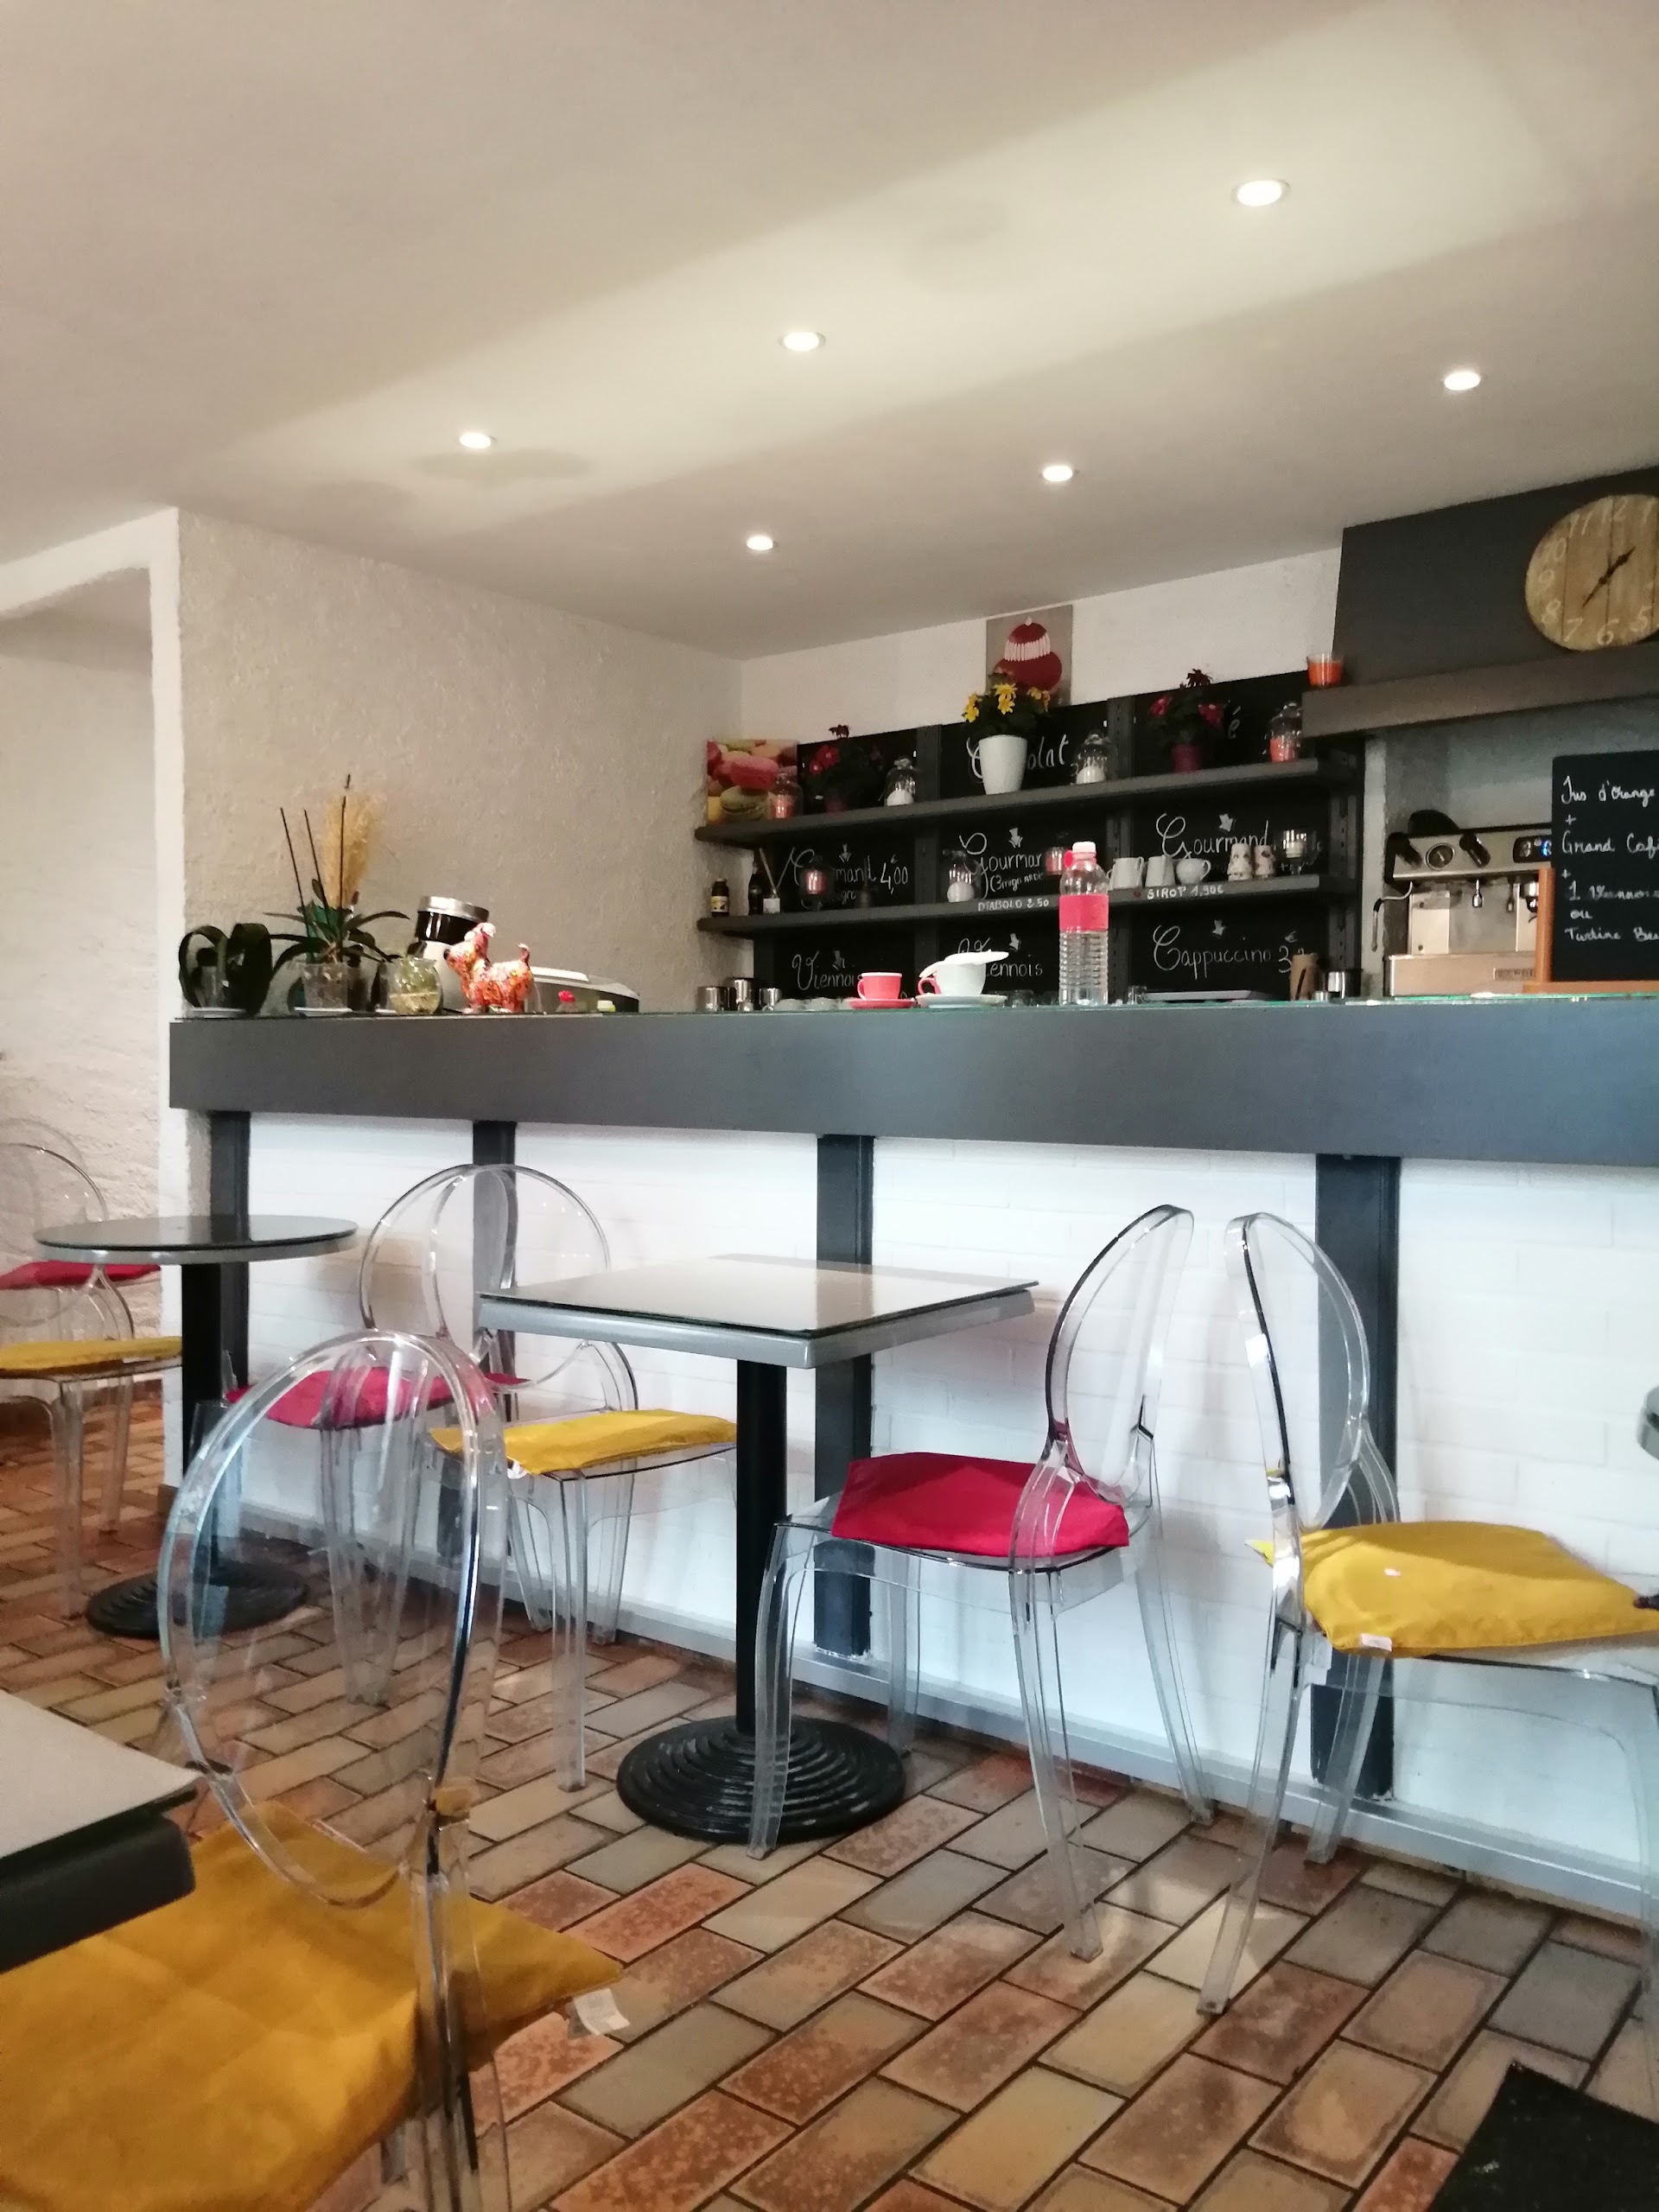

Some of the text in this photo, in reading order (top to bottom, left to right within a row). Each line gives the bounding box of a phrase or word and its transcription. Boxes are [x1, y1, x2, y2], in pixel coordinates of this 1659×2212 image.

[1560, 775, 1587, 804] Jus
[1561, 830, 1616, 855] Grand
[977, 899, 1023, 912] DIABOLO
[1152, 925, 1272, 981] Cappuccino
